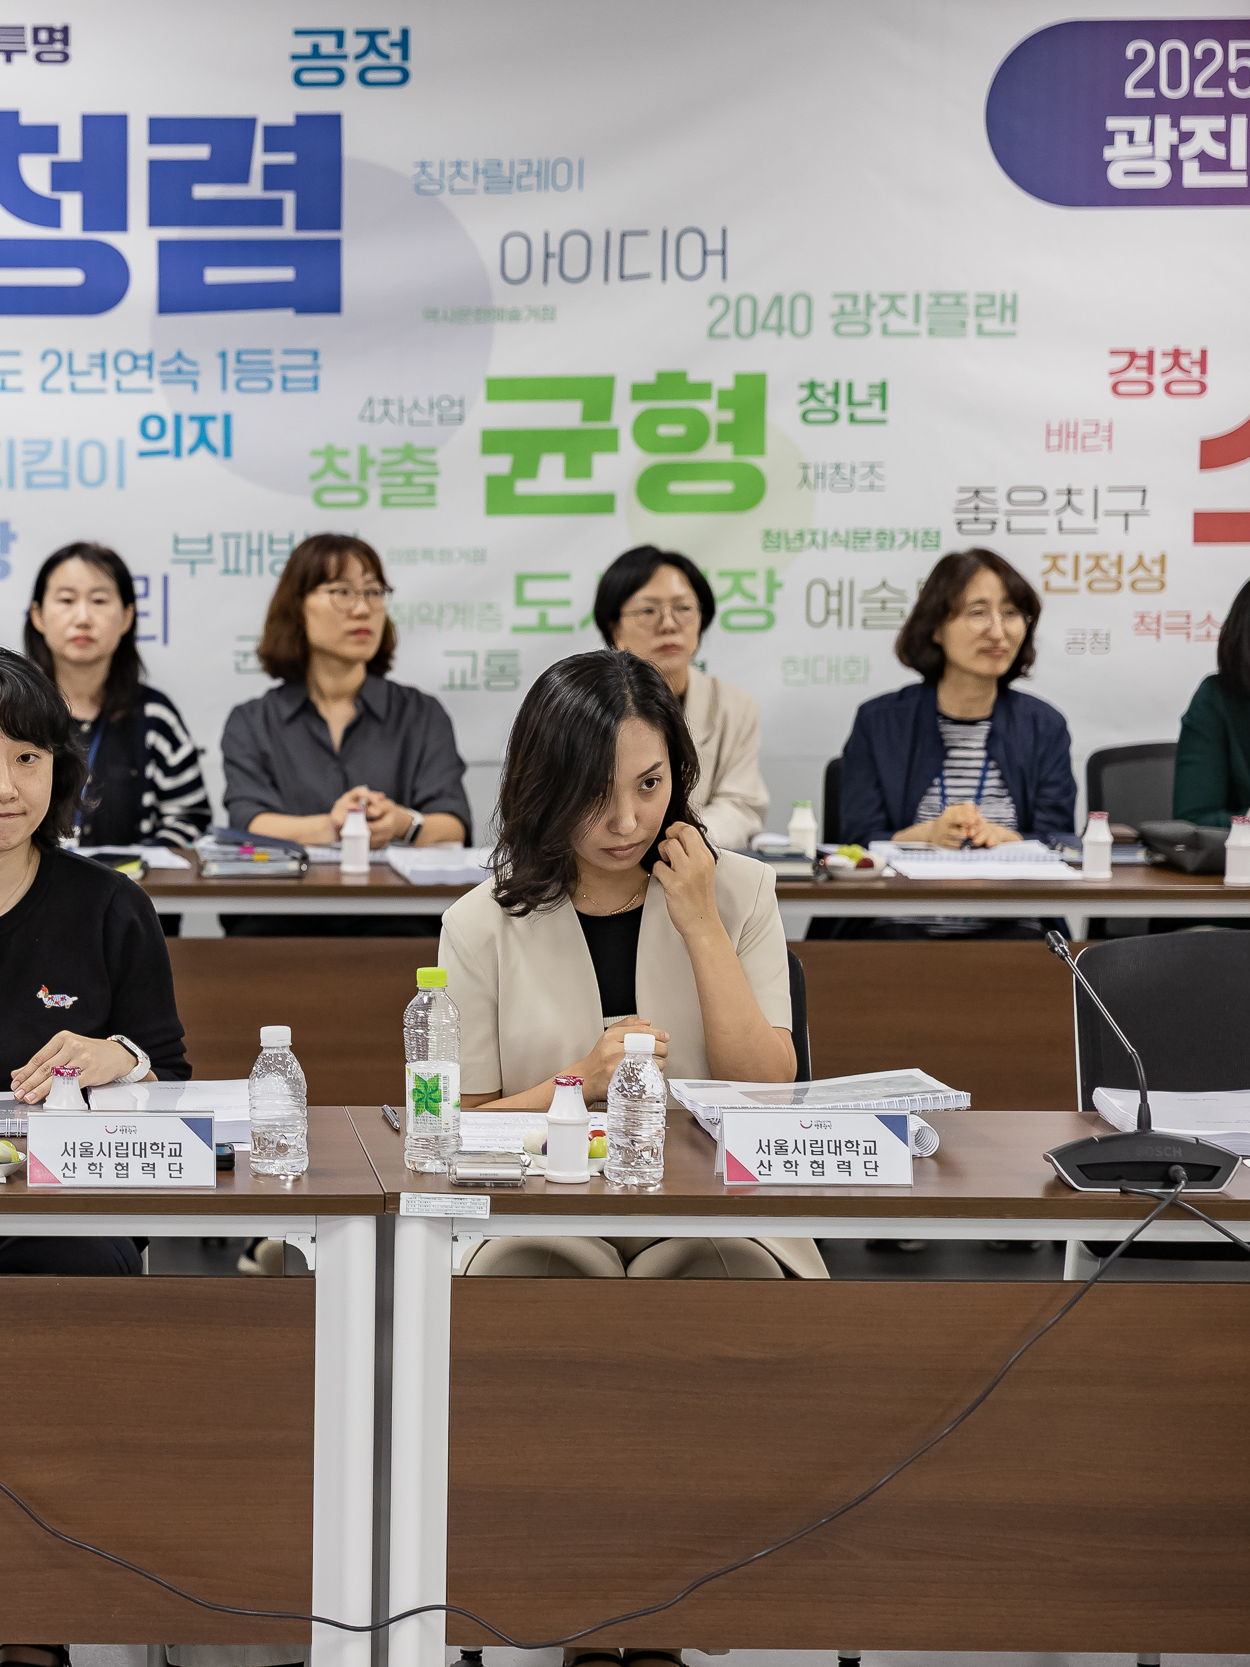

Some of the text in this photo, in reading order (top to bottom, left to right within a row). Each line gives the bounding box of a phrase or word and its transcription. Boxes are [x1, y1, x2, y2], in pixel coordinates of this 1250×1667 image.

[290, 27, 411, 88] 공정
[1124, 38, 1250, 99] 2025
[1102, 113, 1248, 189] 광진
[412, 156, 586, 197] 칭찬릴레이
[500, 226, 728, 286] 아이디어
[707, 290, 1018, 340] 2040 광진플랜
[40, 347, 202, 394] 2년연속
[216, 347, 323, 394] 1등급
[1108, 346, 1209, 398] 경청
[358, 395, 466, 427] 4차산업
[798, 379, 889, 426] 청년
[138, 413, 234, 460] 의지
[481, 370, 768, 516] 균형
[1045, 419, 1114, 454] 배려
[309, 443, 440, 511] 창출
[796, 460, 886, 494] 재창조
[953, 486, 1150, 536] 좋은친구
[1041, 552, 1167, 595] 진정성
[805, 577, 930, 631] 예술
[1065, 628, 1111, 656] 공정
[440, 649, 522, 692] 교통
[60, 1141, 183, 1159] 서울시립대학교
[755, 1138, 879, 1156] 서울시립대학교
[1135, 1145, 1183, 1158] BOSCH
